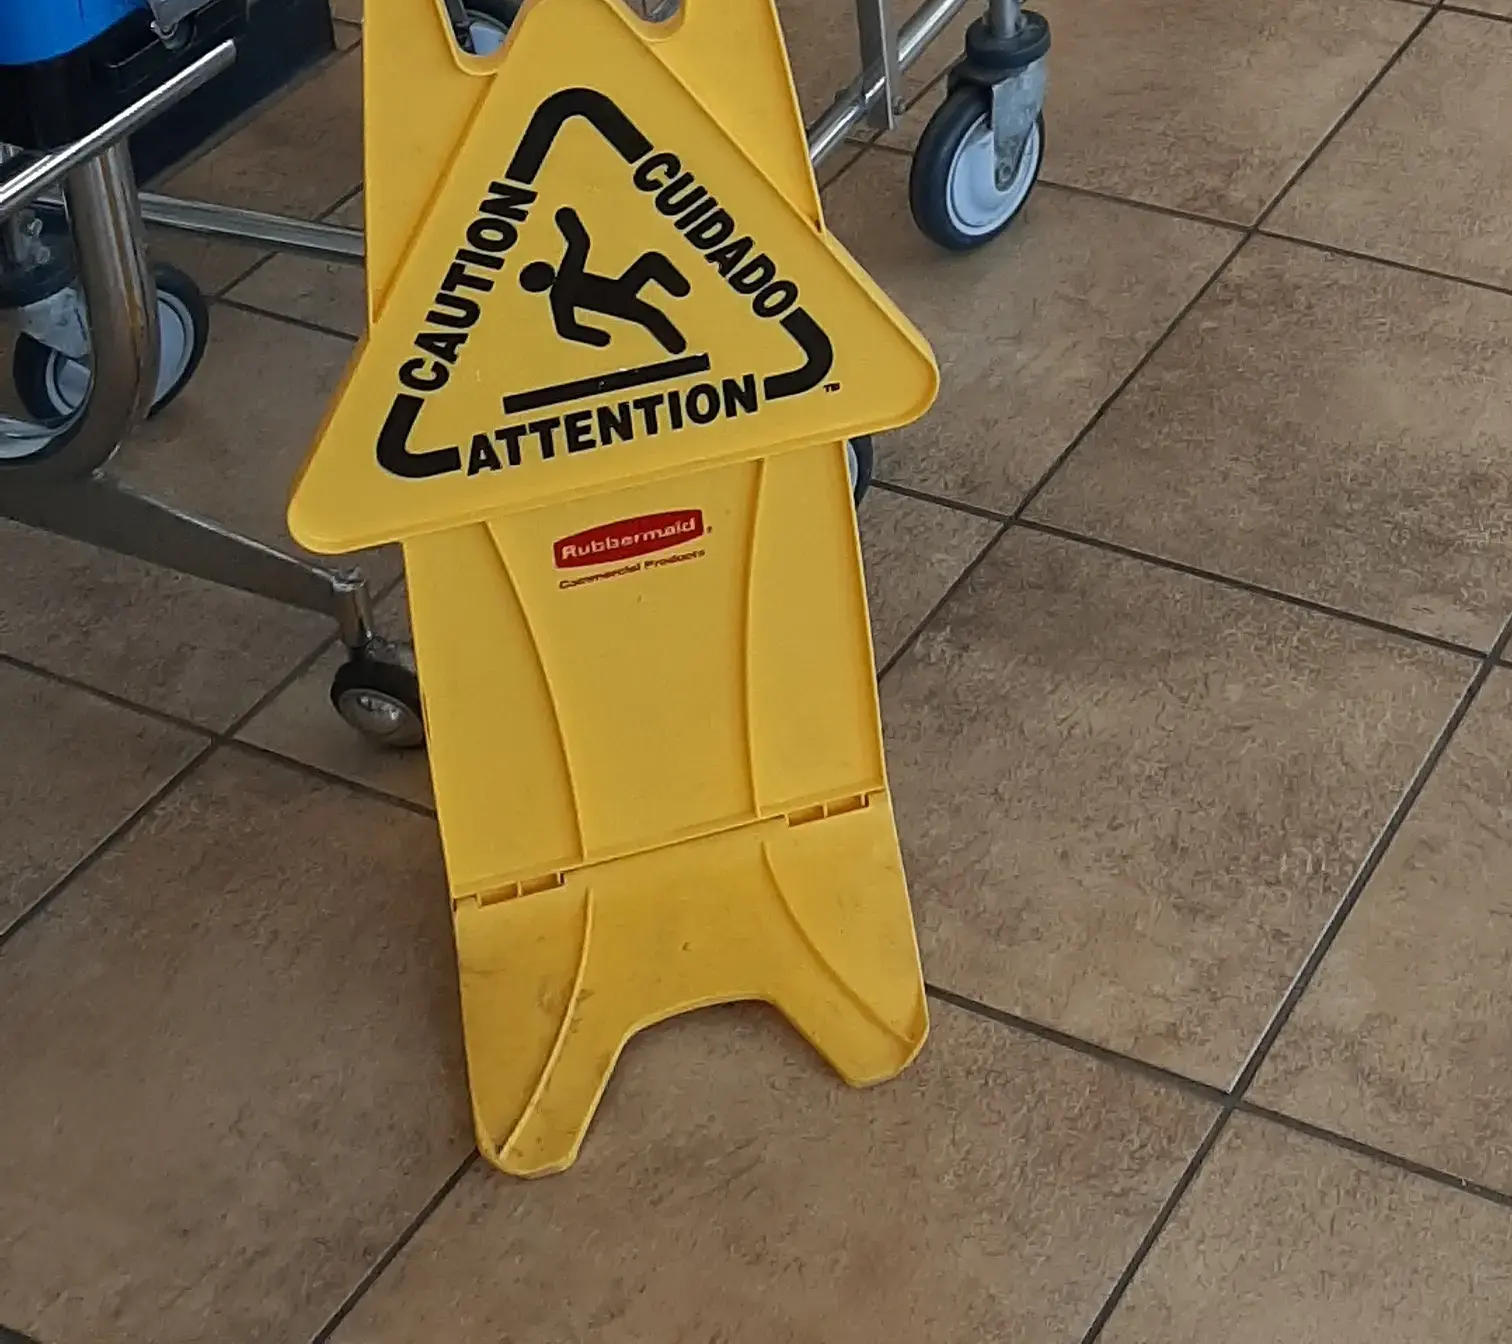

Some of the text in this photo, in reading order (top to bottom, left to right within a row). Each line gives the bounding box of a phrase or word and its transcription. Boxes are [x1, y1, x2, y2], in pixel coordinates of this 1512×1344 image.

[399, 180, 538, 392] CAUTION
[633, 152, 798, 320] CUIDADO
[465, 374, 759, 477] ATTENTION
[559, 548, 706, 590] Commercial Products
[561, 517, 697, 560] Rubbermaid
